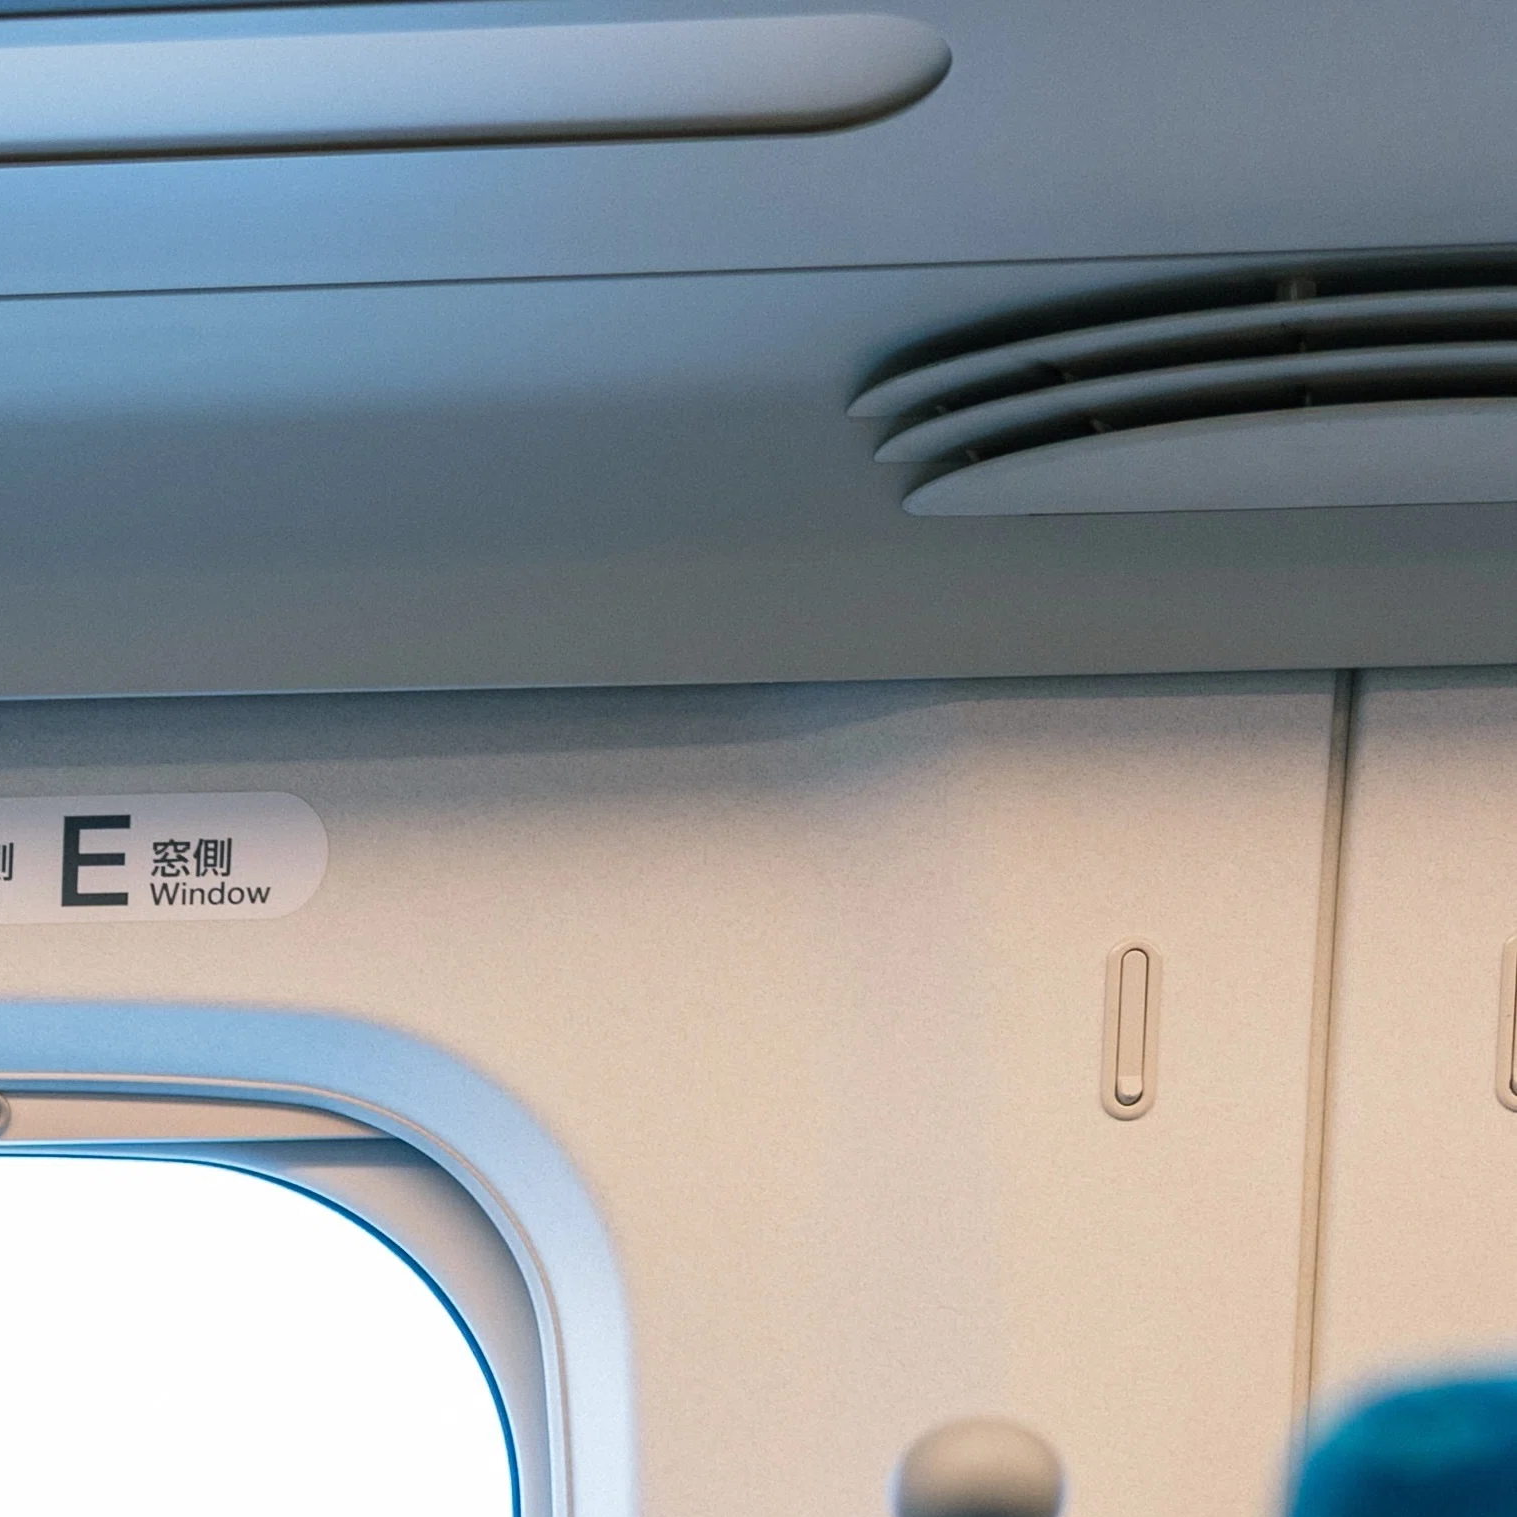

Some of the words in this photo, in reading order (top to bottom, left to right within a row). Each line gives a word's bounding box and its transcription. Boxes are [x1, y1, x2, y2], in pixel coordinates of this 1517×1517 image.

[61, 813, 132, 907] E
[151, 837, 233, 878] 窓側
[149, 881, 271, 907] Window
